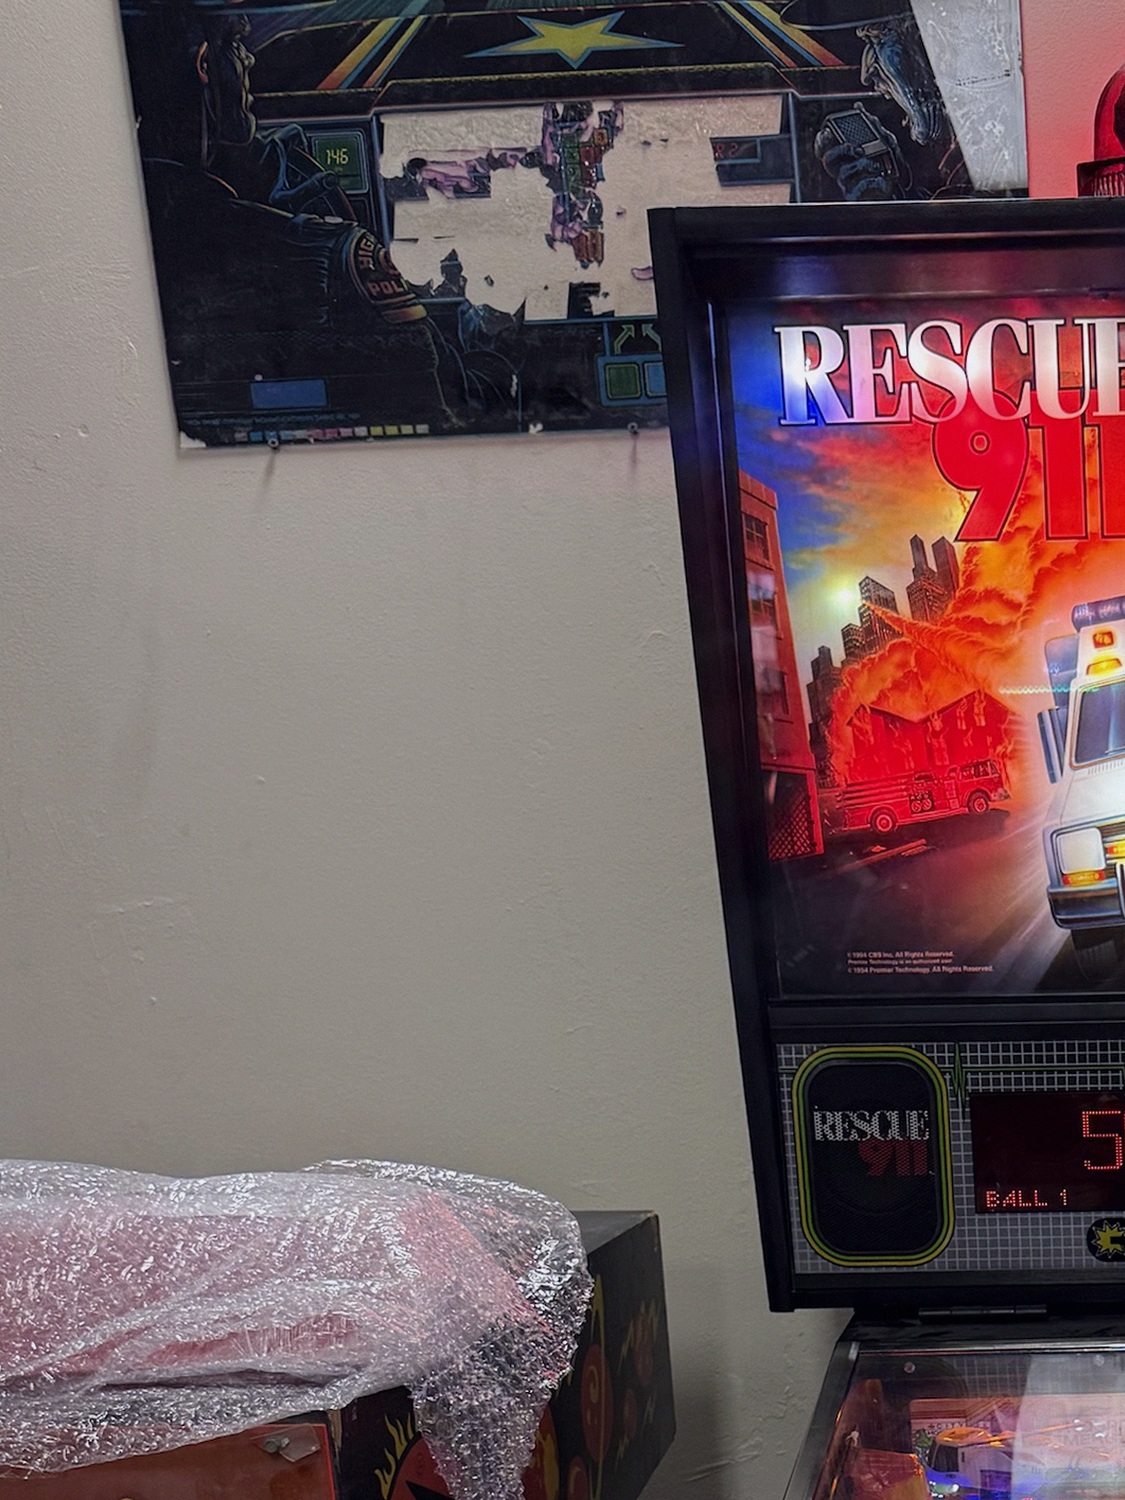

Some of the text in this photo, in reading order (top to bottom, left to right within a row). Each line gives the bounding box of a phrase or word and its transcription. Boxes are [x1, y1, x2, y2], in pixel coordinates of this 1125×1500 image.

[813, 1110, 930, 1142] RESCUE
[858, 1135, 929, 1177] 911
[985, 1189, 1048, 1208] BALL
[1059, 1188, 1069, 1206] 1
